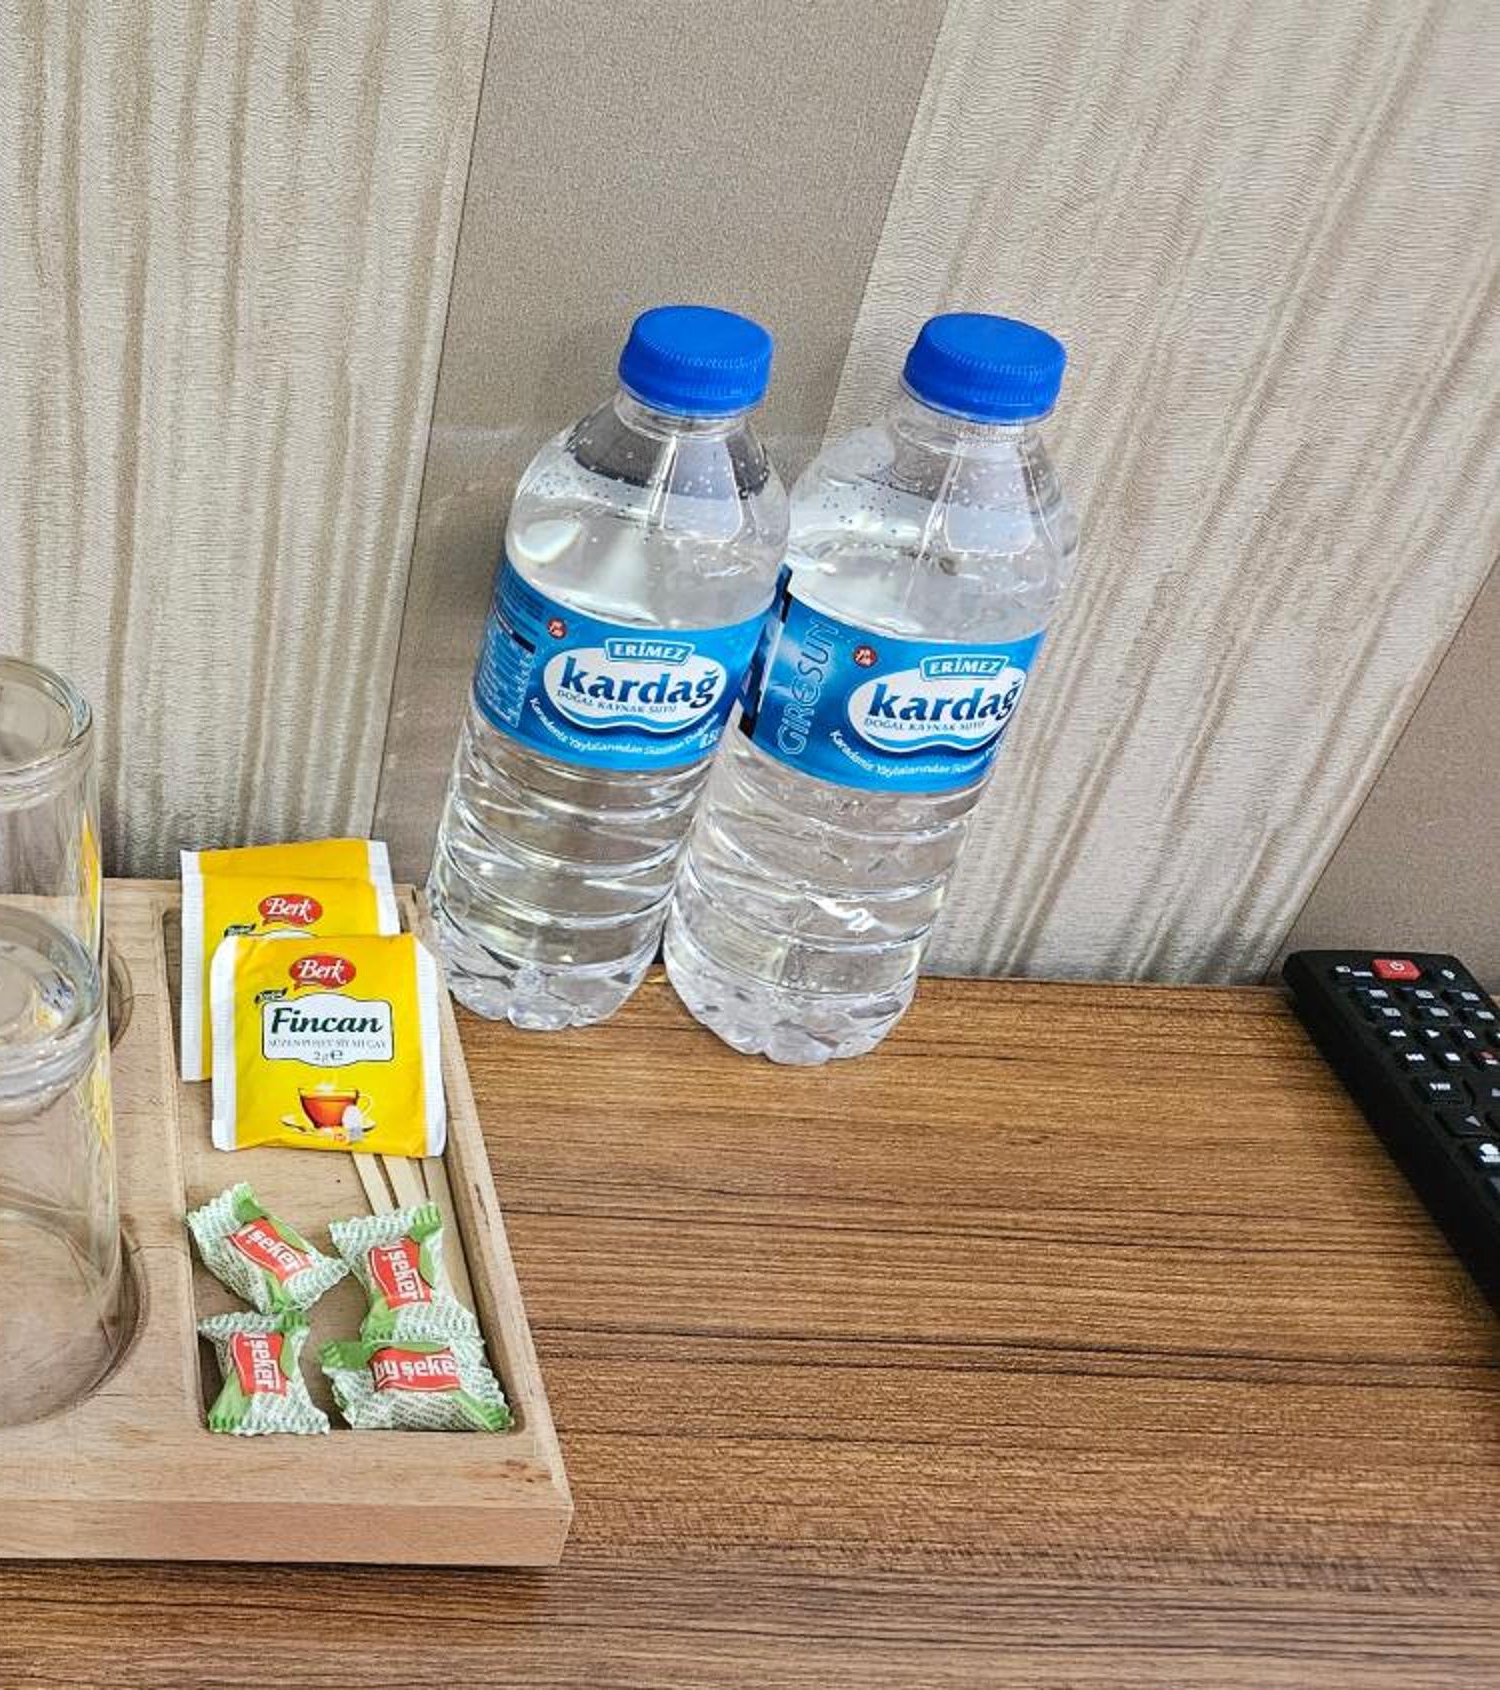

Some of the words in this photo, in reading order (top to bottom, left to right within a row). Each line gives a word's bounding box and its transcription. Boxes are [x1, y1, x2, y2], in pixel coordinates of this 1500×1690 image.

[613, 641, 684, 660] ERİMEZ
[930, 656, 999, 673] ERİMEZ
[560, 656, 720, 708] kardağ
[868, 678, 1022, 721] kardağ
[265, 897, 313, 923] Berk
[298, 959, 346, 985] Berk
[271, 1007, 383, 1034] Fincan
[400, 1354, 458, 1382] şeke
